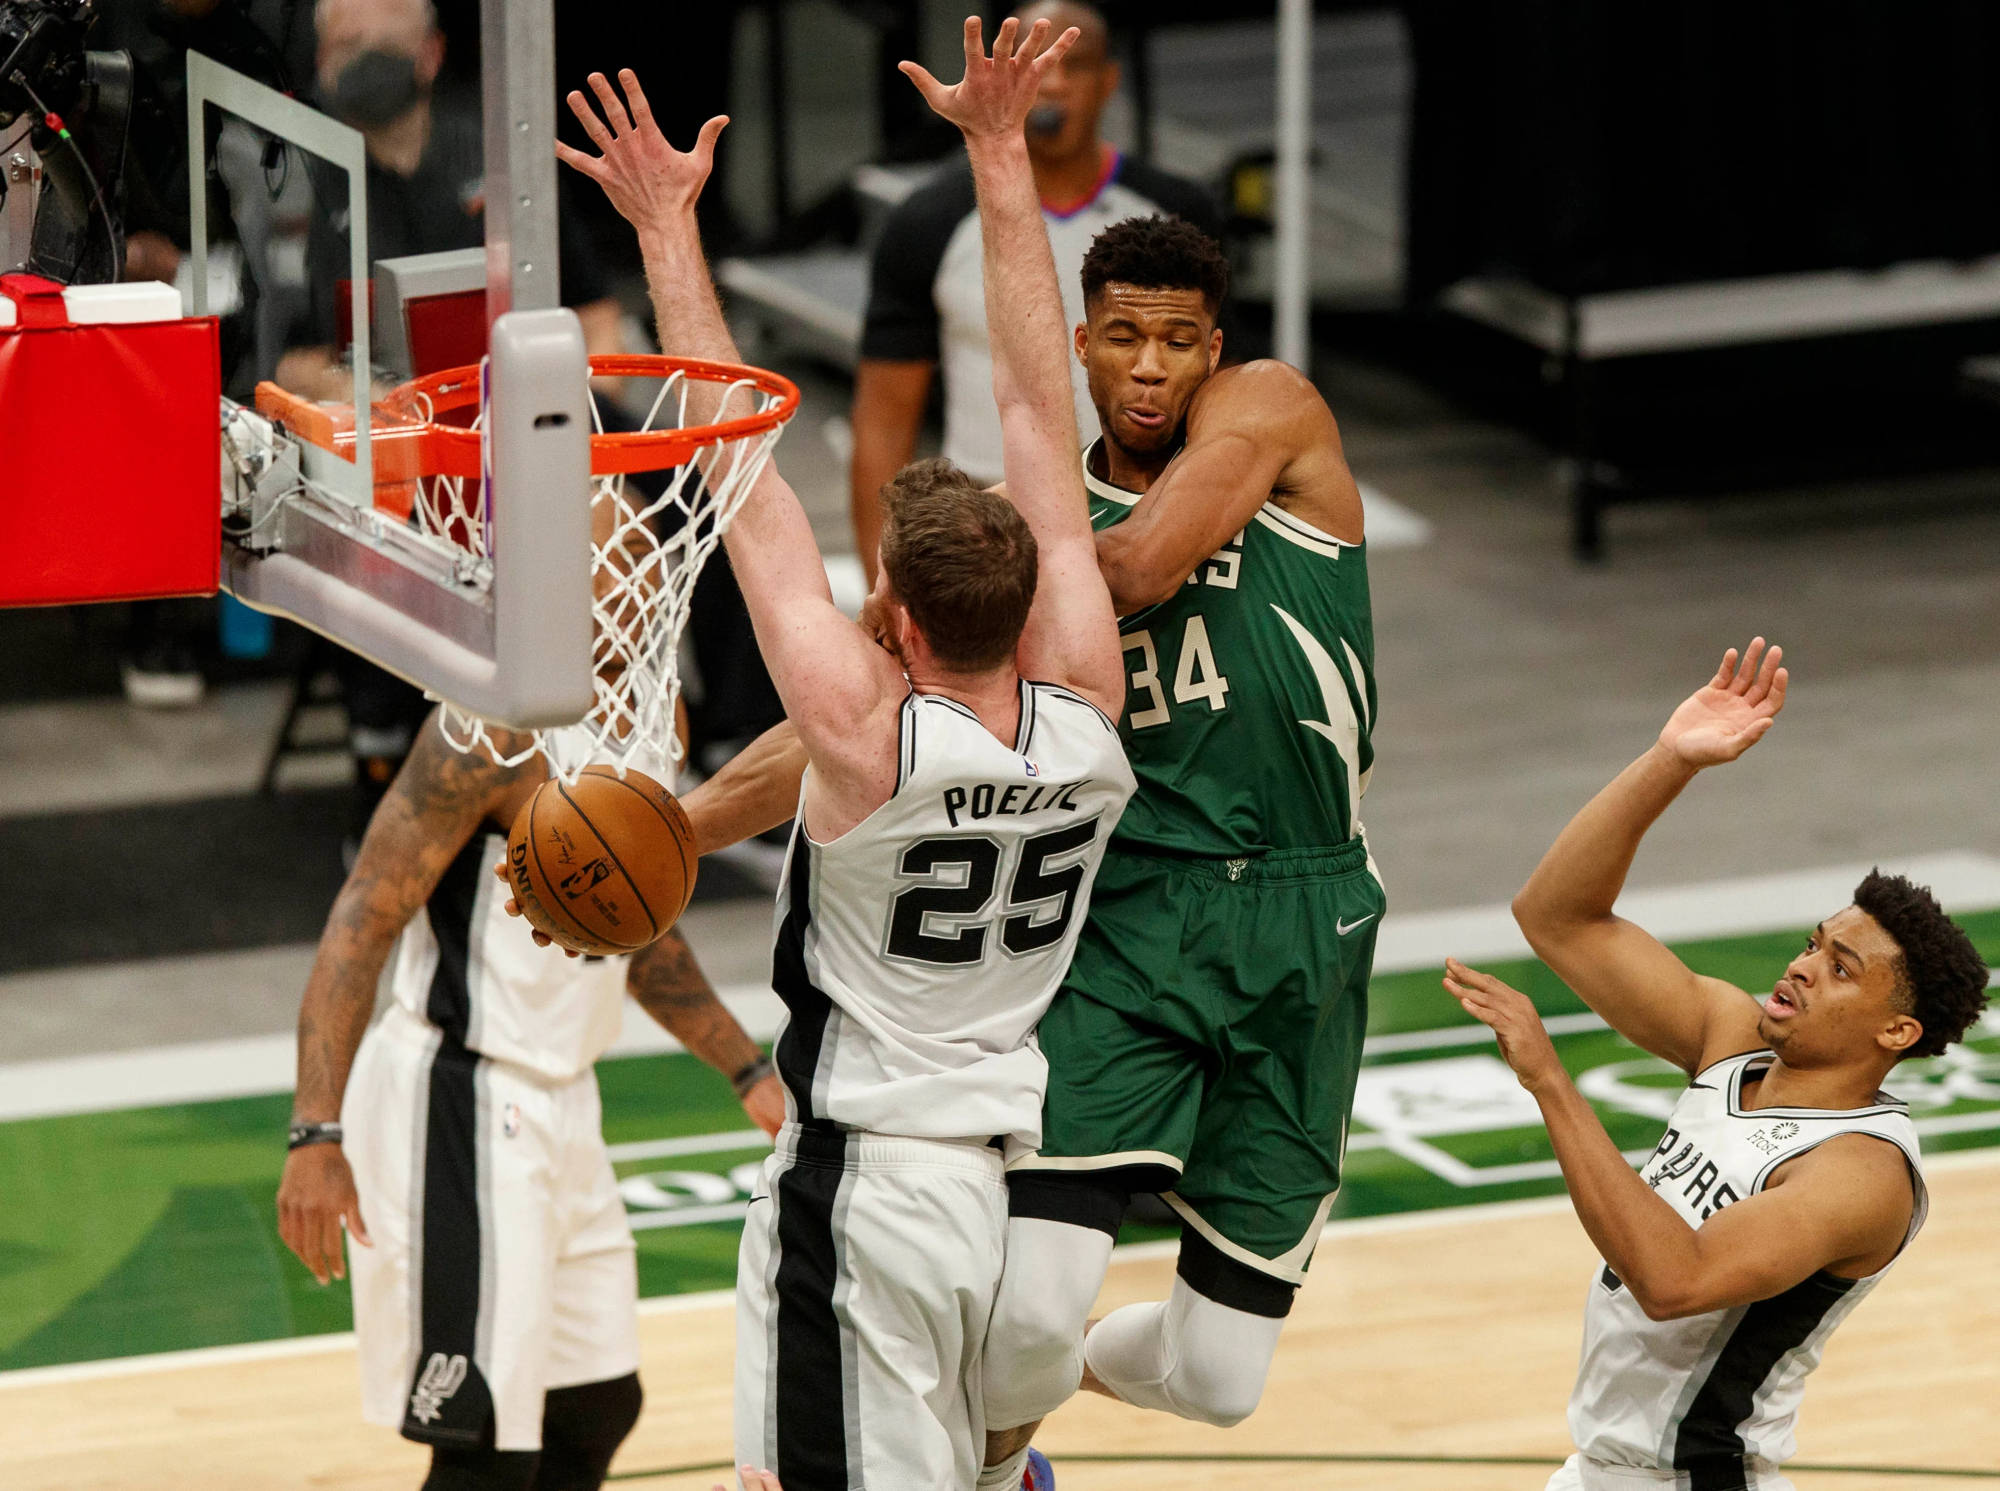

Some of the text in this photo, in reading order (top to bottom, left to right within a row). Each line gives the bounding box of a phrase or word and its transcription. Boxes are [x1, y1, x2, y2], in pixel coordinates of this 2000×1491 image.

[1119, 615, 1229, 730] 34
[881, 809, 1105, 970] 25
[1648, 1128, 1740, 1221] PURS
[1746, 1129, 1780, 1156] Frost
